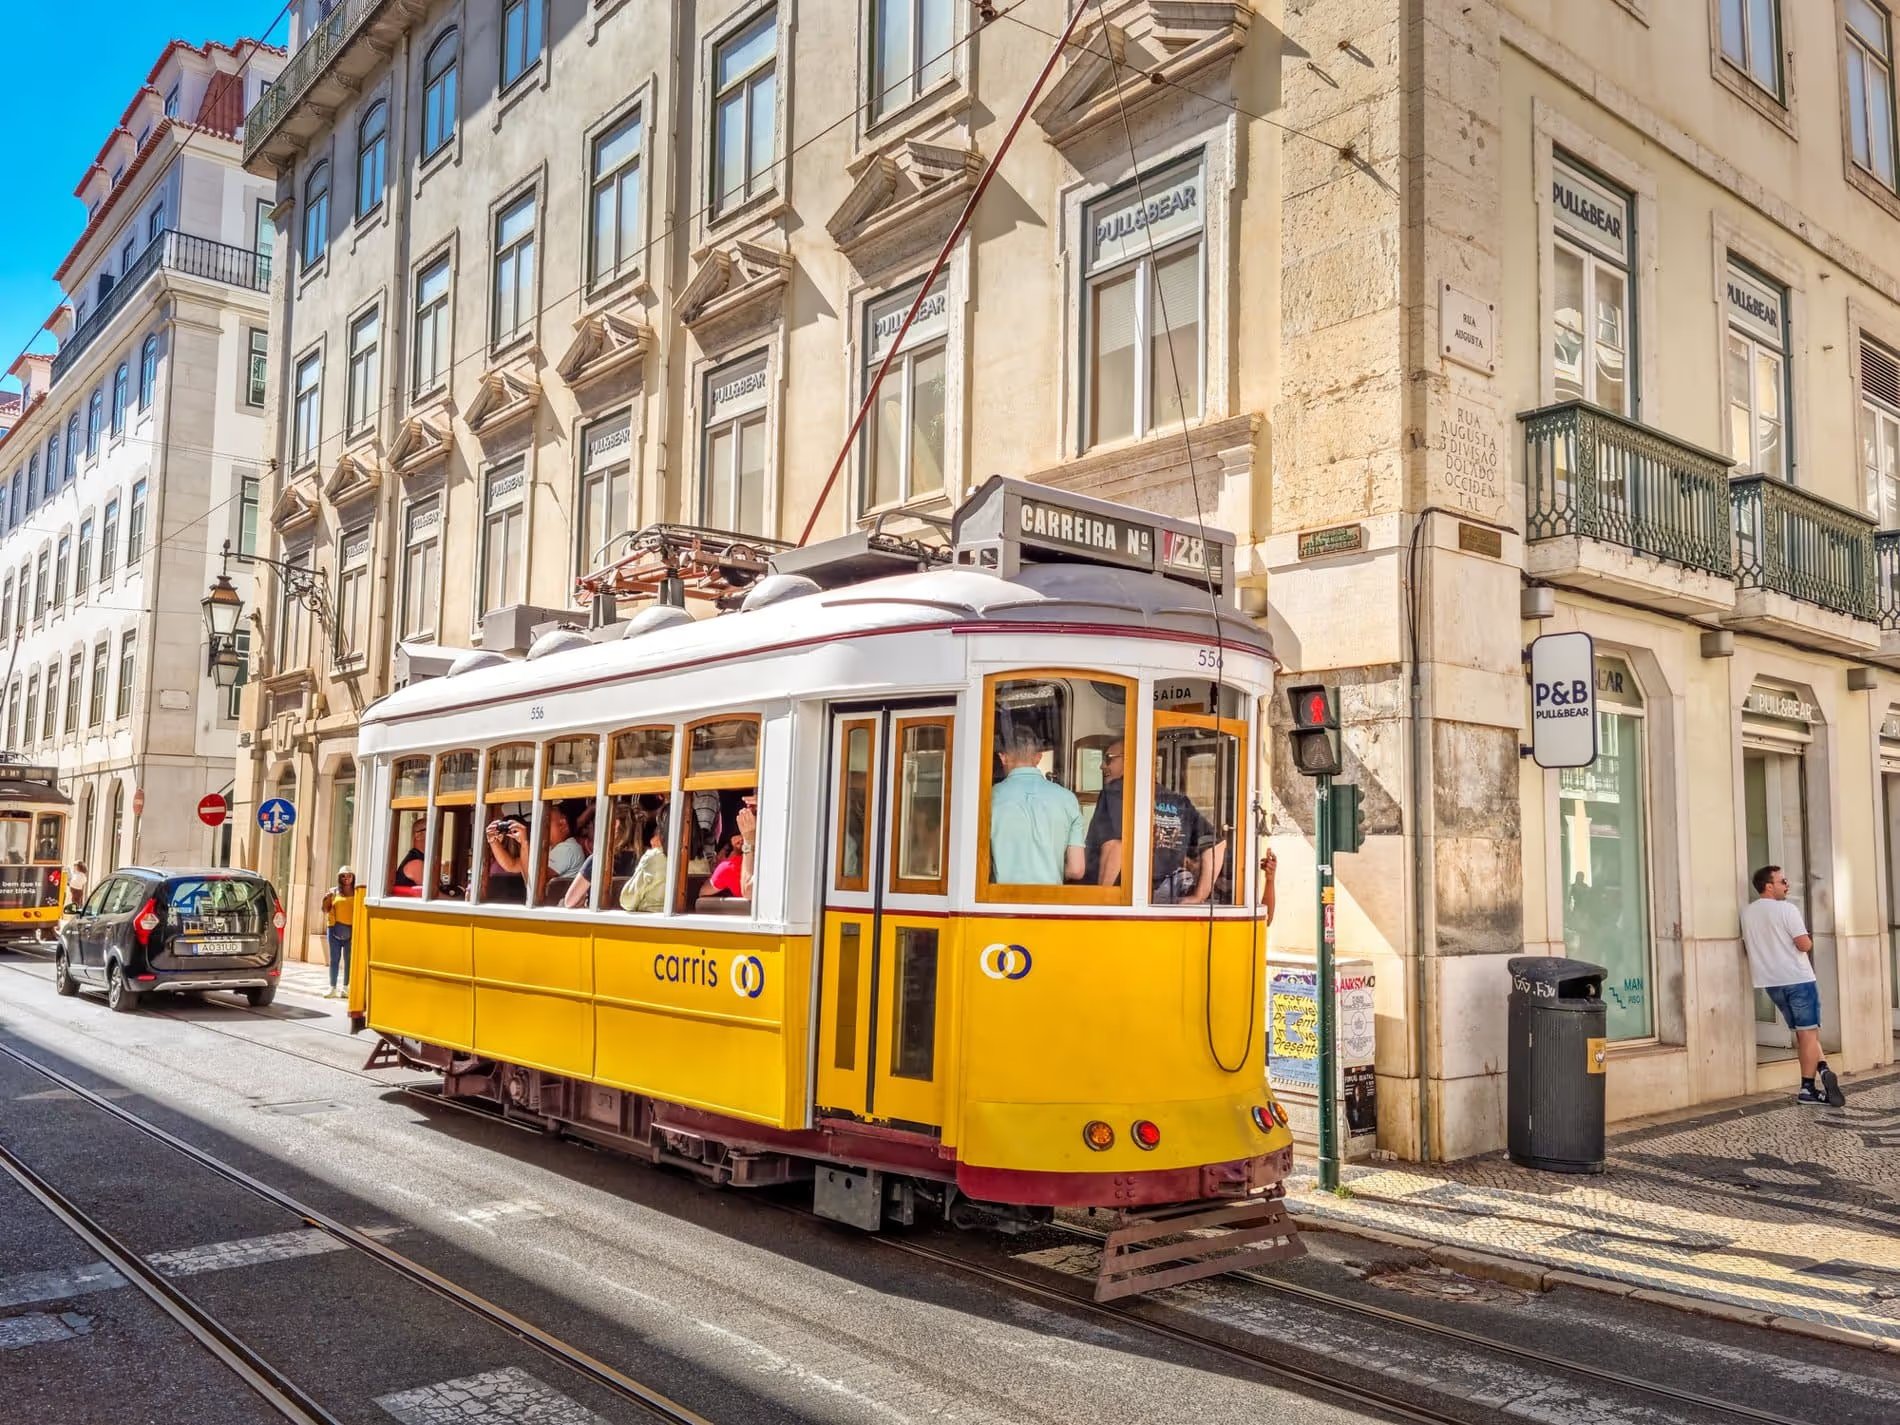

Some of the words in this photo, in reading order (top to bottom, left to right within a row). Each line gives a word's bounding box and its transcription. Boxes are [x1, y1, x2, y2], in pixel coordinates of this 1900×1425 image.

[1096, 185, 1196, 246] PULL&BEAR
[1553, 181, 1621, 240] PULL&BEAR
[874, 294, 946, 338] PULLEAR
[1462, 313, 1476, 327] RUA
[1454, 328, 1484, 349] AUGUSTA
[1457, 407, 1481, 429] RUA
[1440, 419, 1497, 453] AUGUSTA
[1445, 471, 1496, 498] OCCIDEN
[1457, 491, 1481, 513] TAL
[1020, 504, 1117, 552] CARREIRA
[1173, 532, 1205, 567] 28
[1198, 649, 1223, 669] 556
[1153, 686, 1192, 702] SAÍDA
[1535, 680, 1588, 706] P&B
[530, 705, 544, 720] 556
[1536, 707, 1589, 719] PULL&BEAR
[1759, 693, 1813, 721] PULL&BEAR
[654, 948, 718, 988] carris
